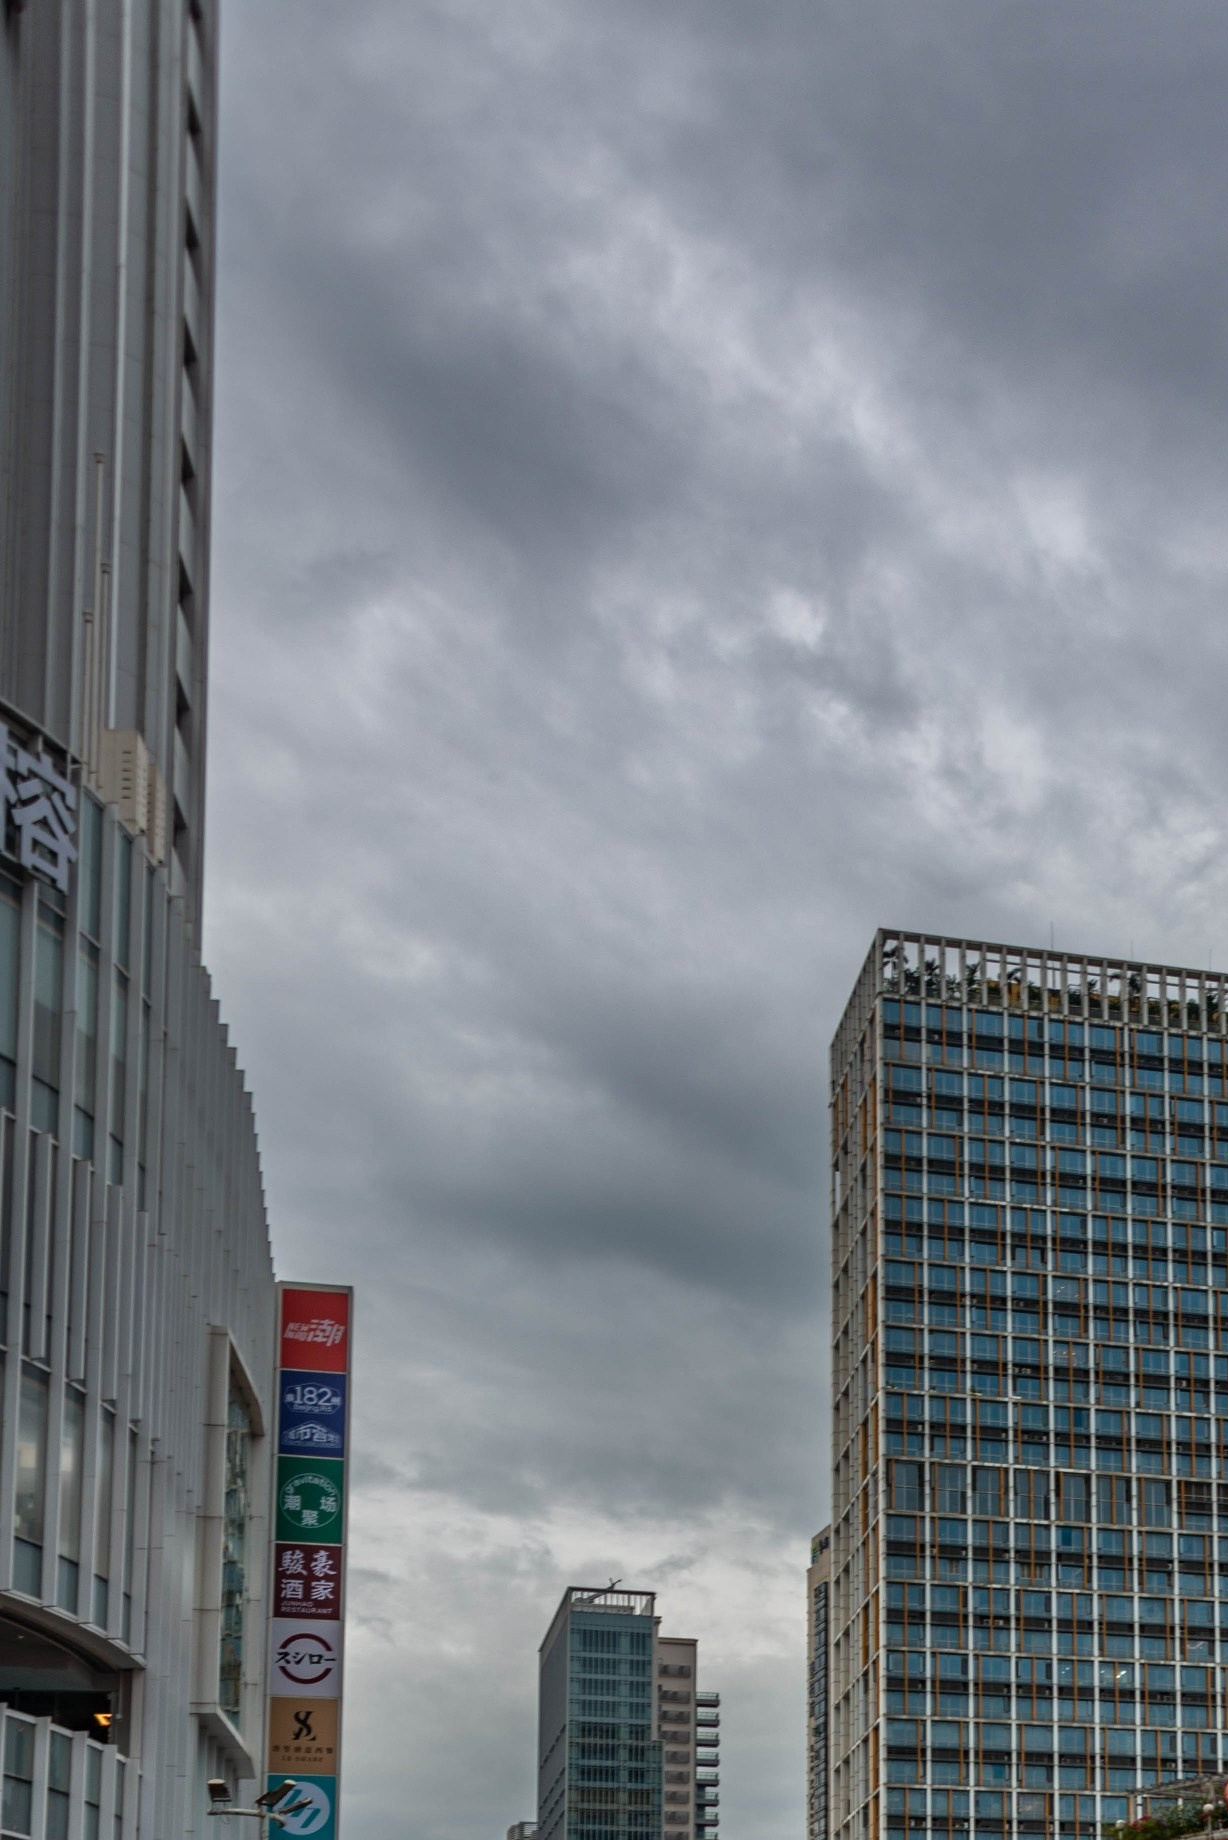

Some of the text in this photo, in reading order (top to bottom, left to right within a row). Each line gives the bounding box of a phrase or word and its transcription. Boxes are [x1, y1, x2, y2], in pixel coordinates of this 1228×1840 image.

[294, 1386, 333, 1405] 182
[280, 1579, 335, 1600] 酒家
[274, 1651, 337, 1665] スシロー
